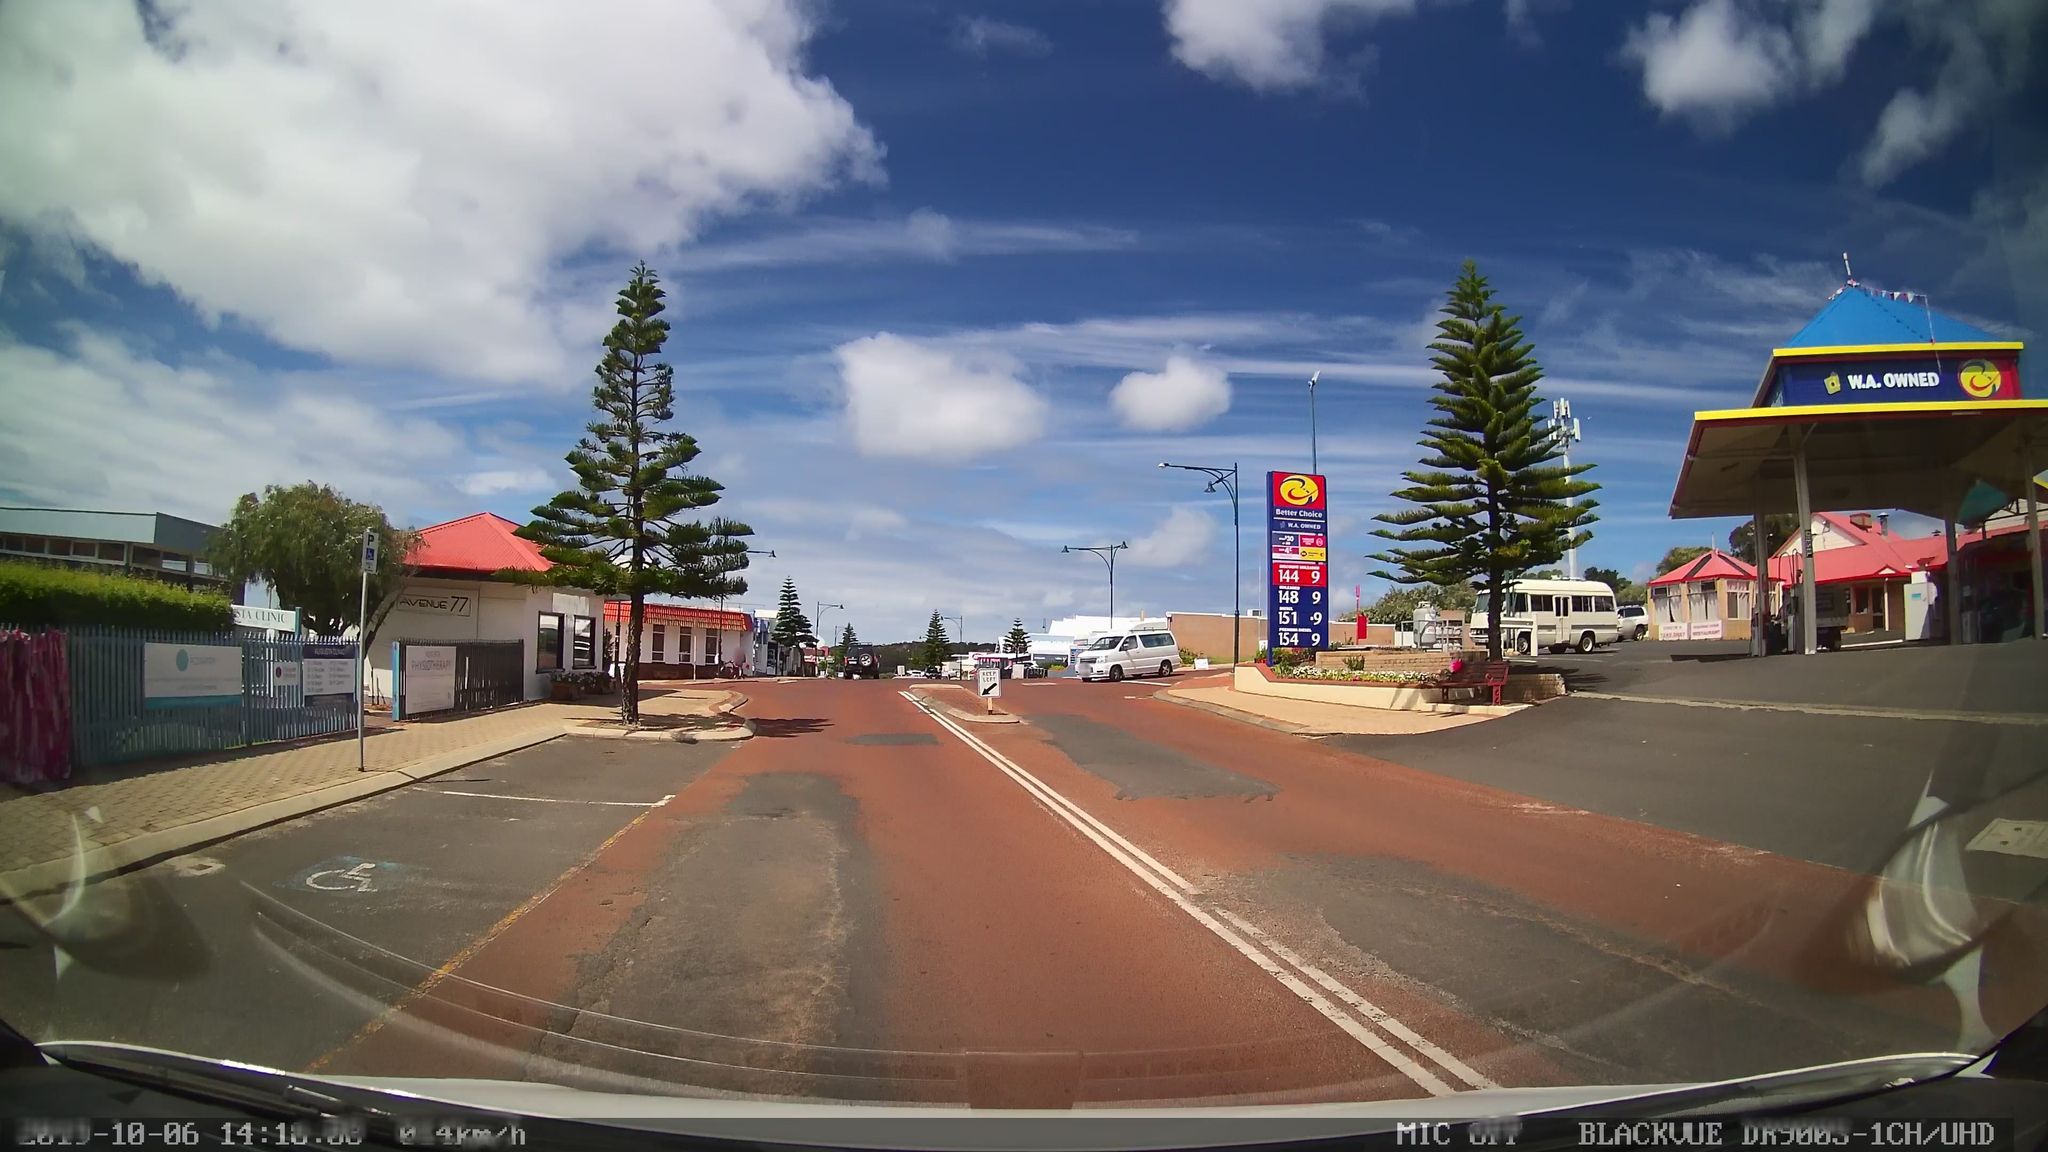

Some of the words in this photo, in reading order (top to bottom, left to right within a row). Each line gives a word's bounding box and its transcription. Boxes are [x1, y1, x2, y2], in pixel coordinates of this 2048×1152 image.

[1847, 374, 1882, 389] W.A.
[1883, 372, 1940, 388] OWNED
[1299, 510, 1323, 518] Choice
[367, 534, 375, 546] P
[1278, 569, 1299, 583] 144
[1311, 570, 1321, 584] 9
[400, 598, 448, 610] AVENUE
[450, 595, 469, 613] 77
[1278, 590, 1299, 604] 148
[1312, 591, 1321, 605] 9
[255, 611, 285, 624] CLINIC
[1278, 611, 1298, 625] 151
[1278, 632, 1299, 646] 154
[1311, 633, 1321, 647] 9
